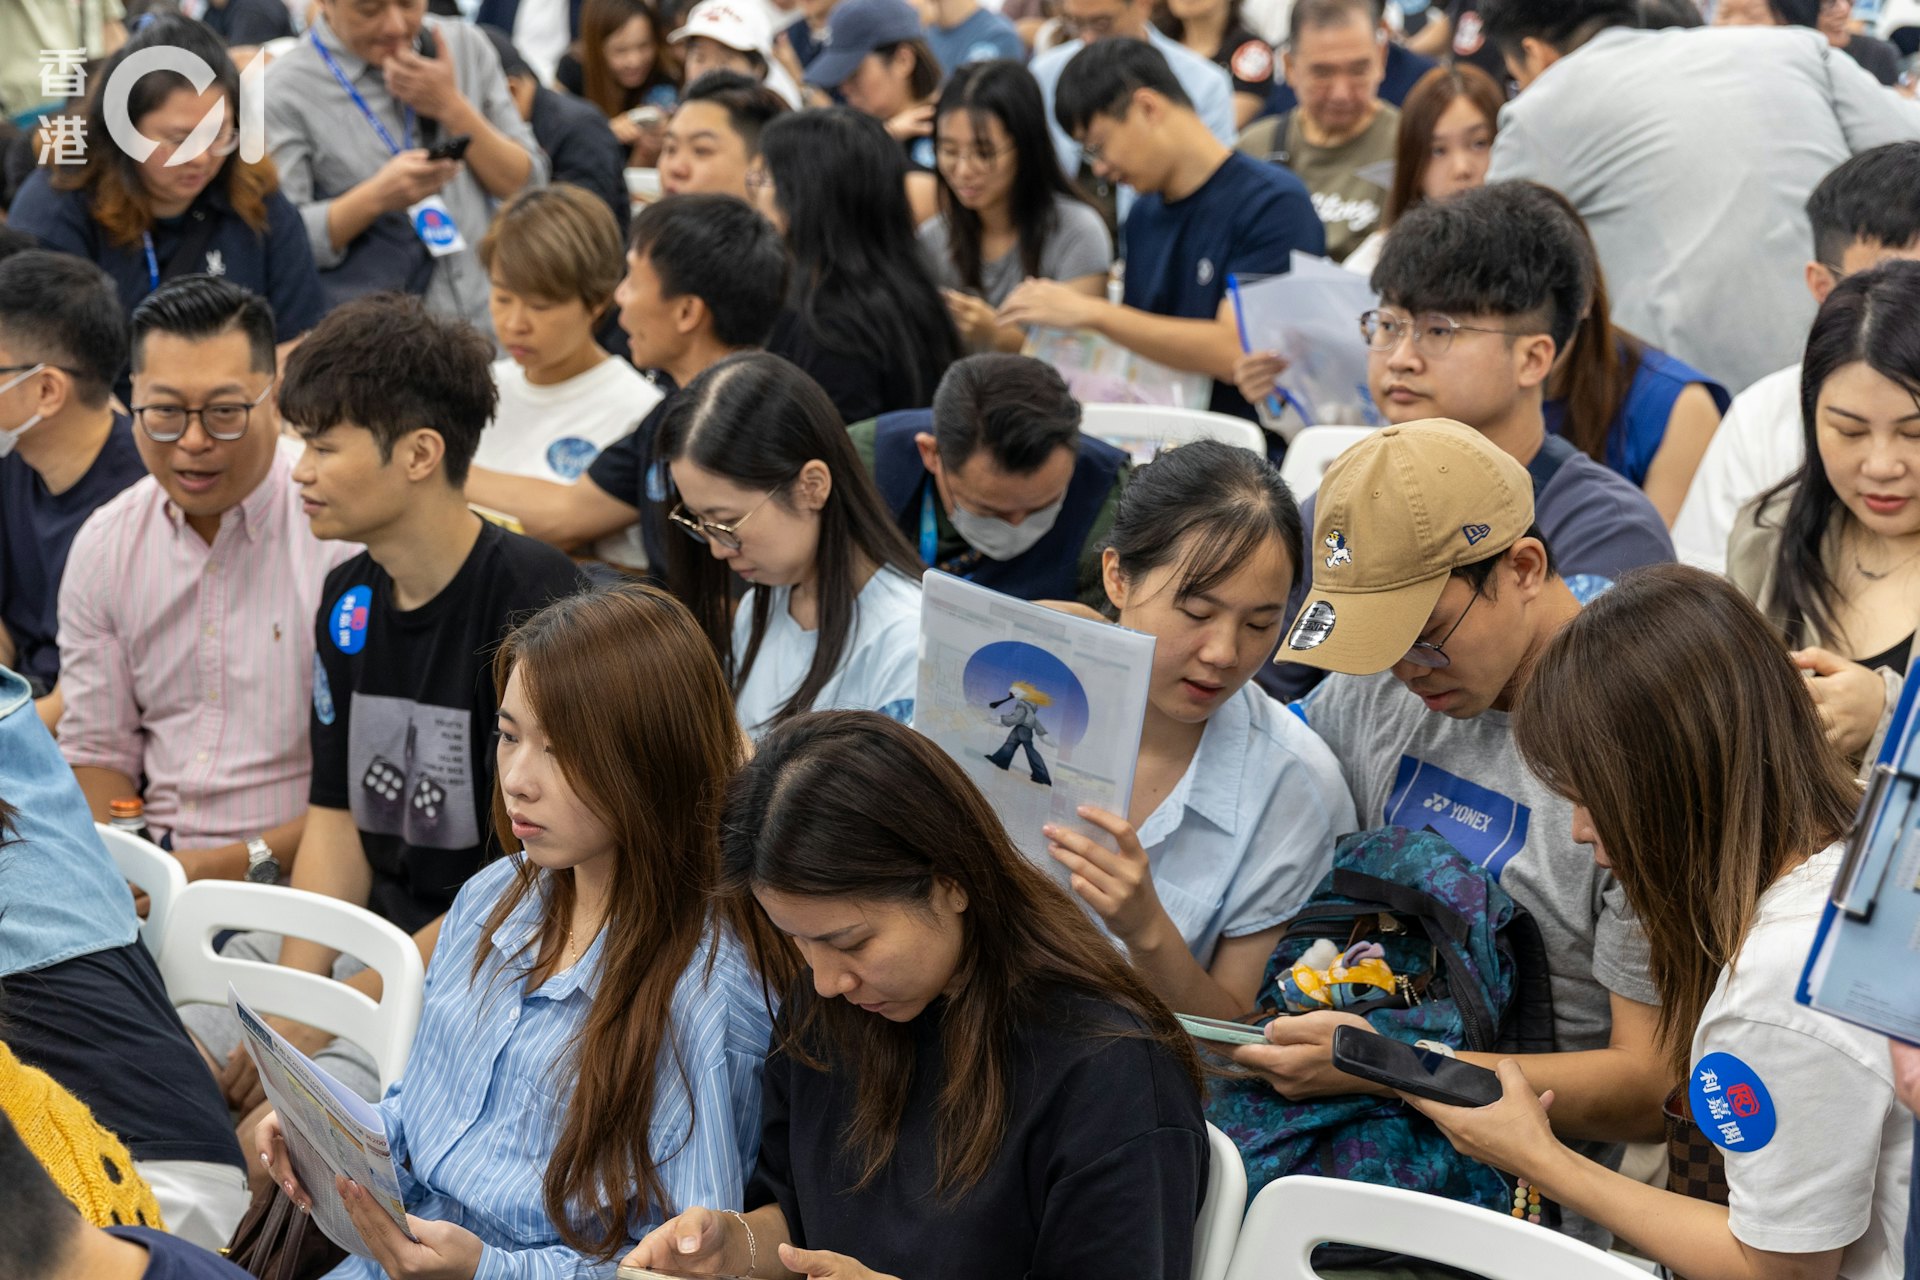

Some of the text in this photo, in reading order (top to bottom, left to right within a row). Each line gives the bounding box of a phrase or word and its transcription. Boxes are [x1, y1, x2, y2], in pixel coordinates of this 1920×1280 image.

[1449, 801, 1493, 832] YONEX
[1700, 1067, 1744, 1145] 利嘉閣
